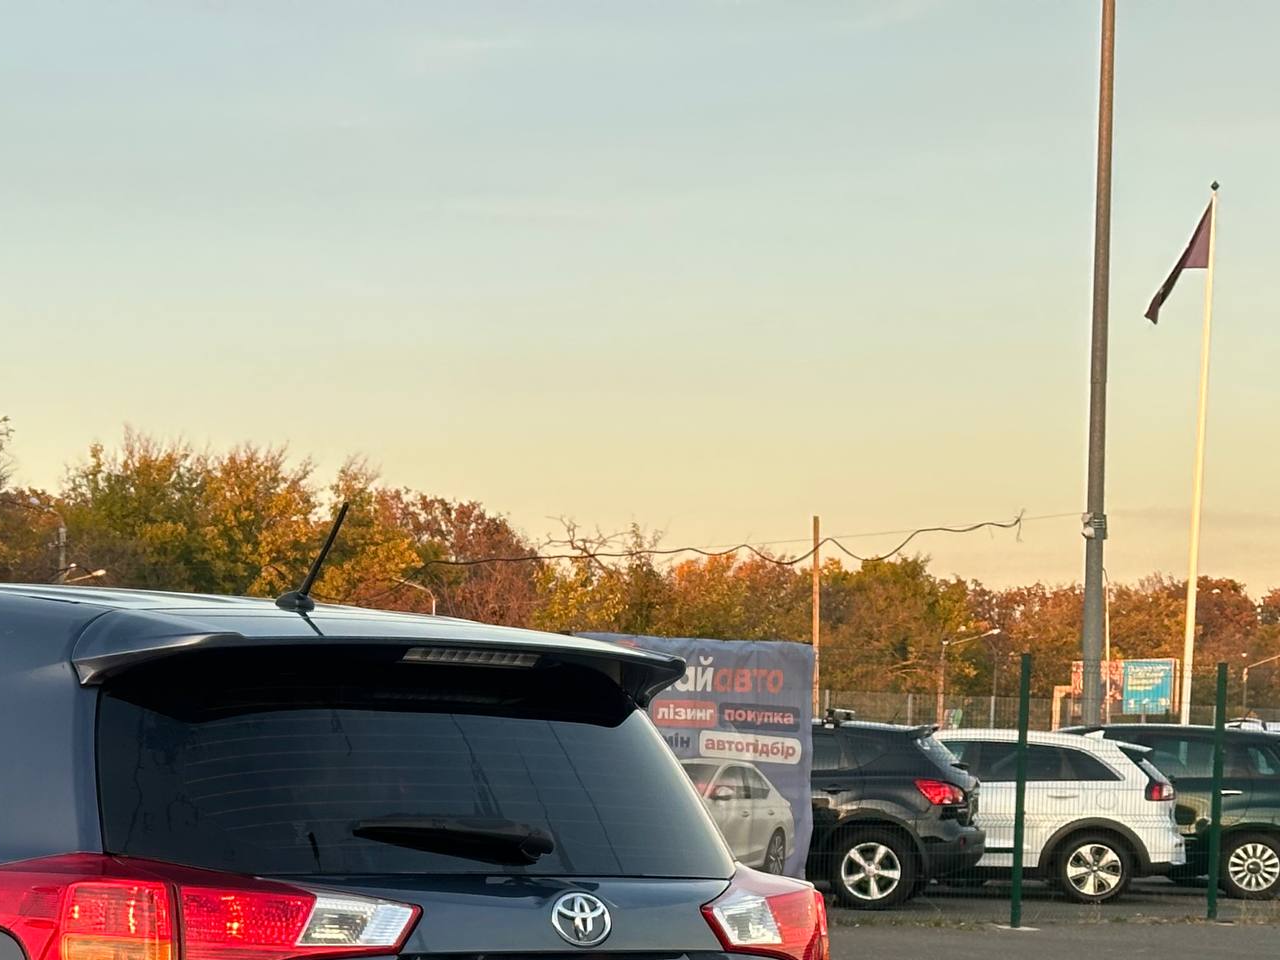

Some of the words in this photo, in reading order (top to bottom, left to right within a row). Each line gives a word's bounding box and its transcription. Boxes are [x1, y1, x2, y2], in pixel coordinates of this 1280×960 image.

[657, 703, 714, 721] лізинг
[724, 708, 794, 725] покупка
[664, 732, 690, 749] мін
[704, 737, 796, 760] автопідбір
